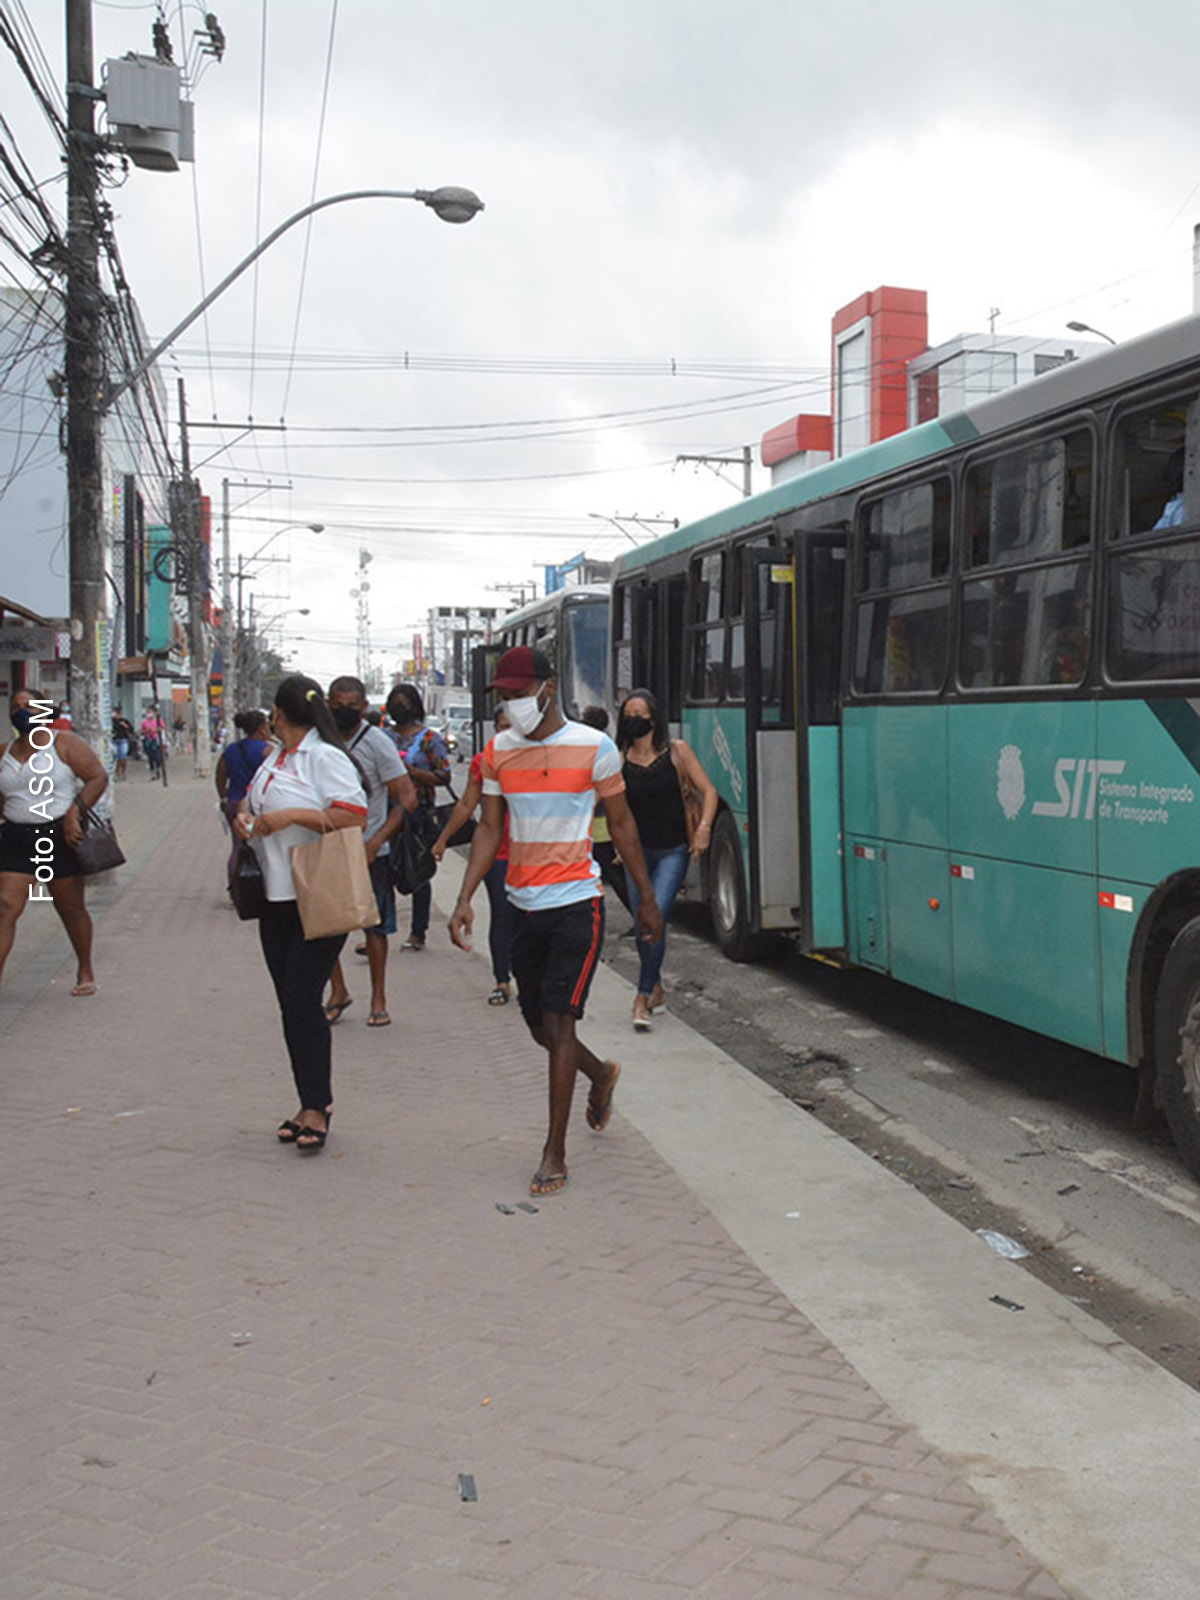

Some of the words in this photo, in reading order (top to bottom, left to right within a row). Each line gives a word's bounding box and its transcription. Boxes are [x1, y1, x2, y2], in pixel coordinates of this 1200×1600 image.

[1031, 757, 1126, 821] SIT
[1099, 778, 1137, 799] Sistema
[1139, 780, 1194, 806] Integrado
[1098, 799, 1112, 819] de
[1113, 801, 1169, 826] Transporte
